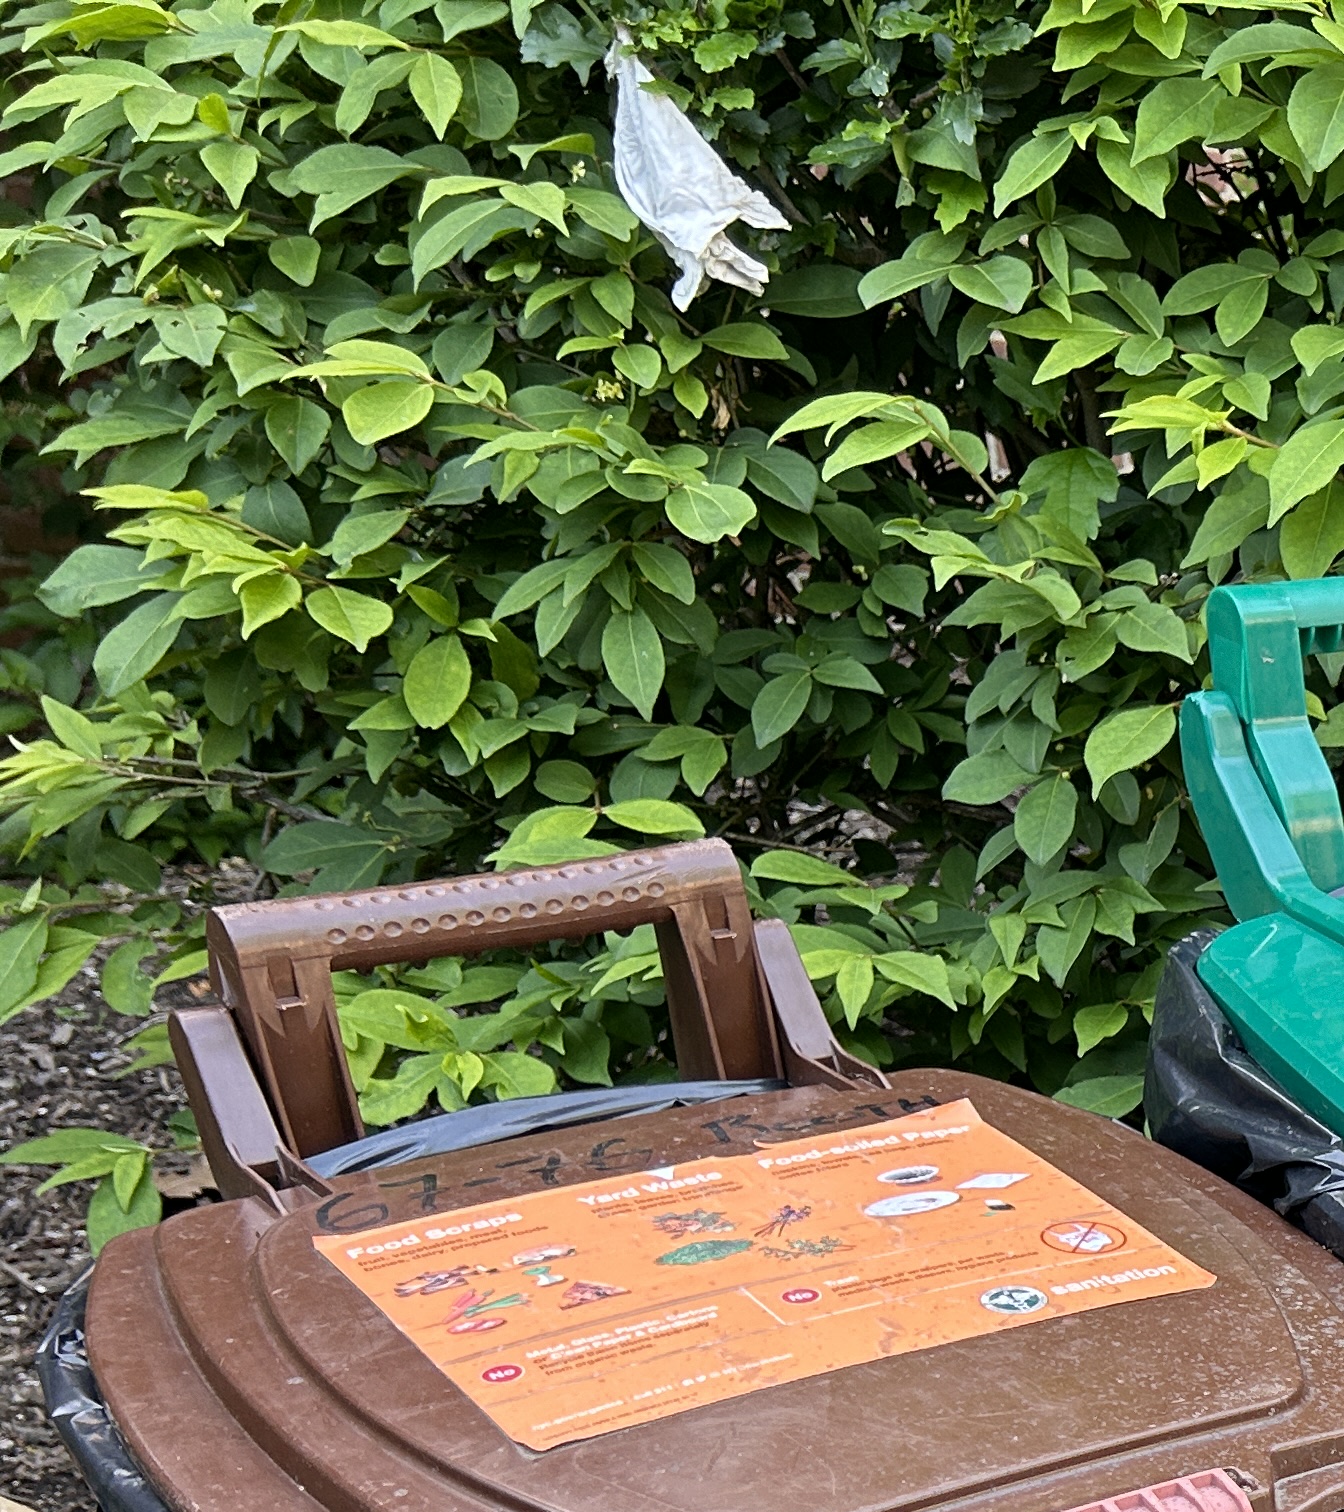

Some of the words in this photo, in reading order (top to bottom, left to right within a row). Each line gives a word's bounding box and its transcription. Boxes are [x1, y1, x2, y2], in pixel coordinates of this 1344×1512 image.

[758, 1134, 900, 1169] Food-soiled
[902, 1125, 969, 1142] Paper
[577, 1187, 640, 1205] Yard
[641, 1171, 722, 1193] Waste
[346, 1233, 421, 1259] Food
[424, 1213, 523, 1240] Scraps
[1050, 1265, 1178, 1295] sanitation
